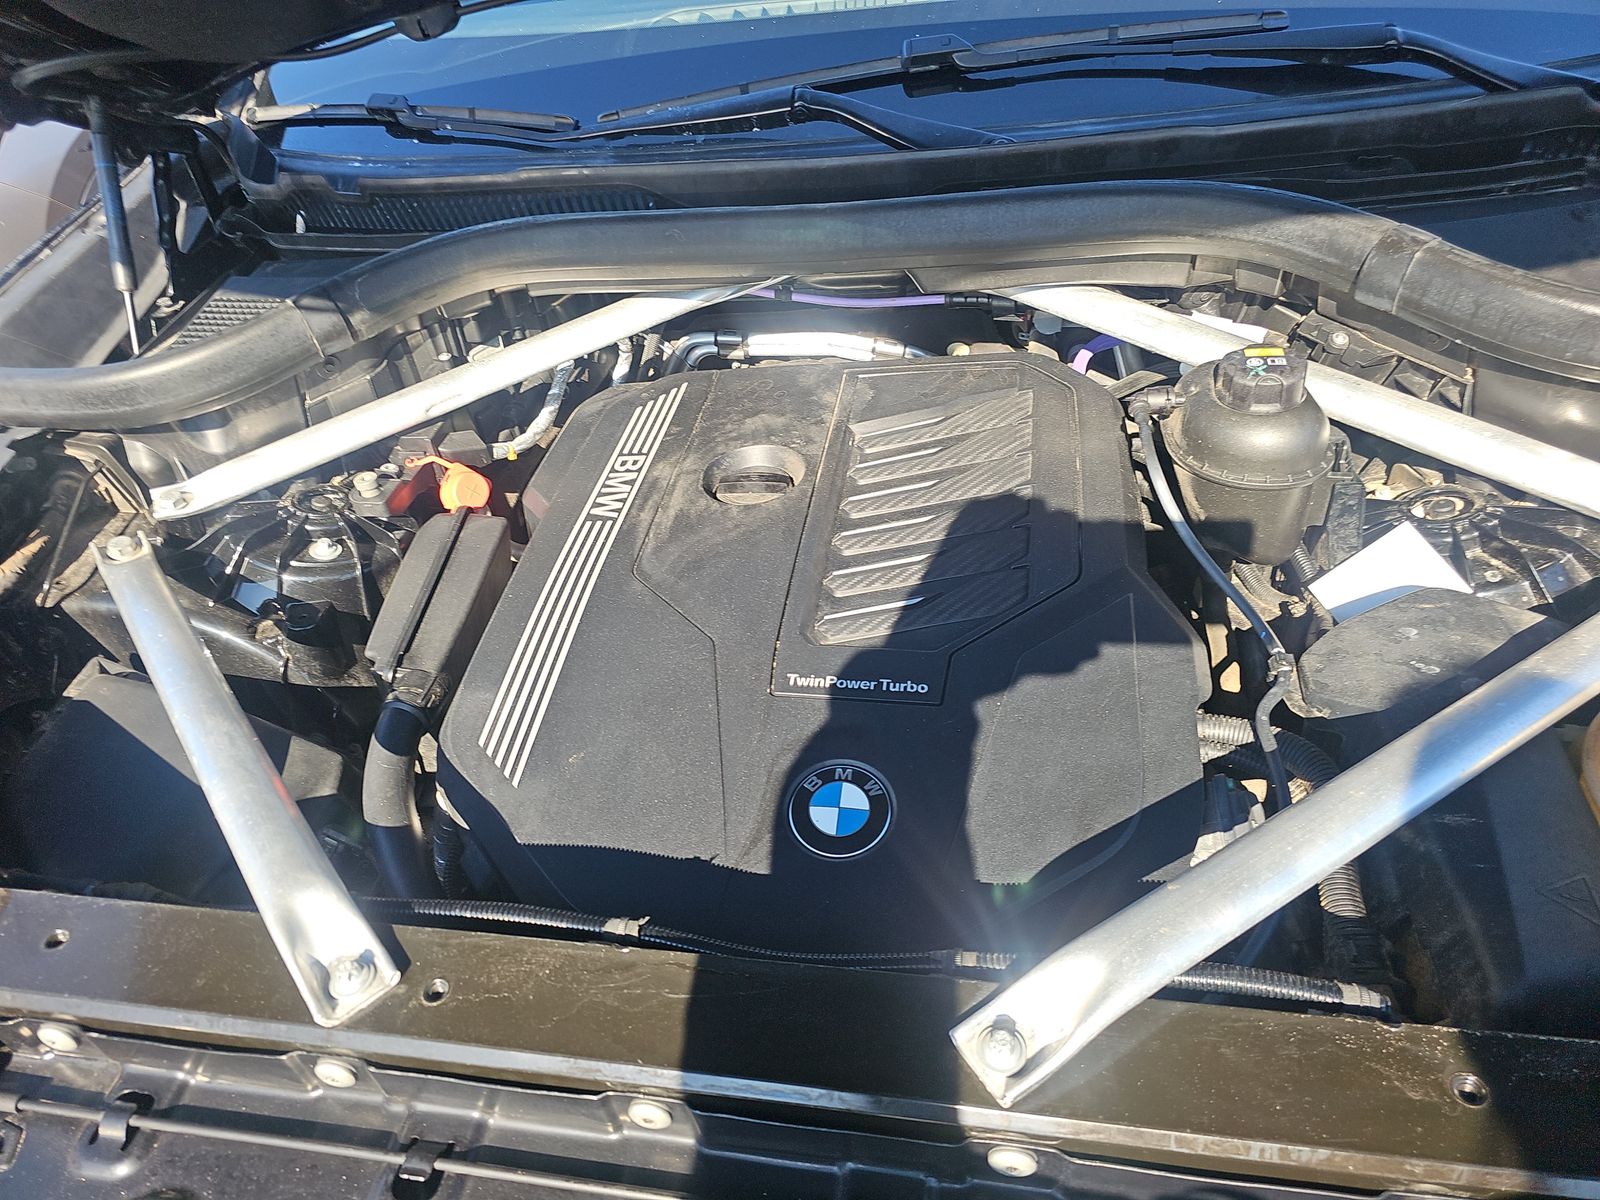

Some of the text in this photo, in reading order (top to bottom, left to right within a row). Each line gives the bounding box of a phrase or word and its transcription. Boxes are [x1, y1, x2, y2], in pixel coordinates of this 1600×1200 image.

[590, 454, 646, 518] BMW
[786, 673, 928, 693] TwinPower Turbo
[804, 768, 884, 796] BMW
